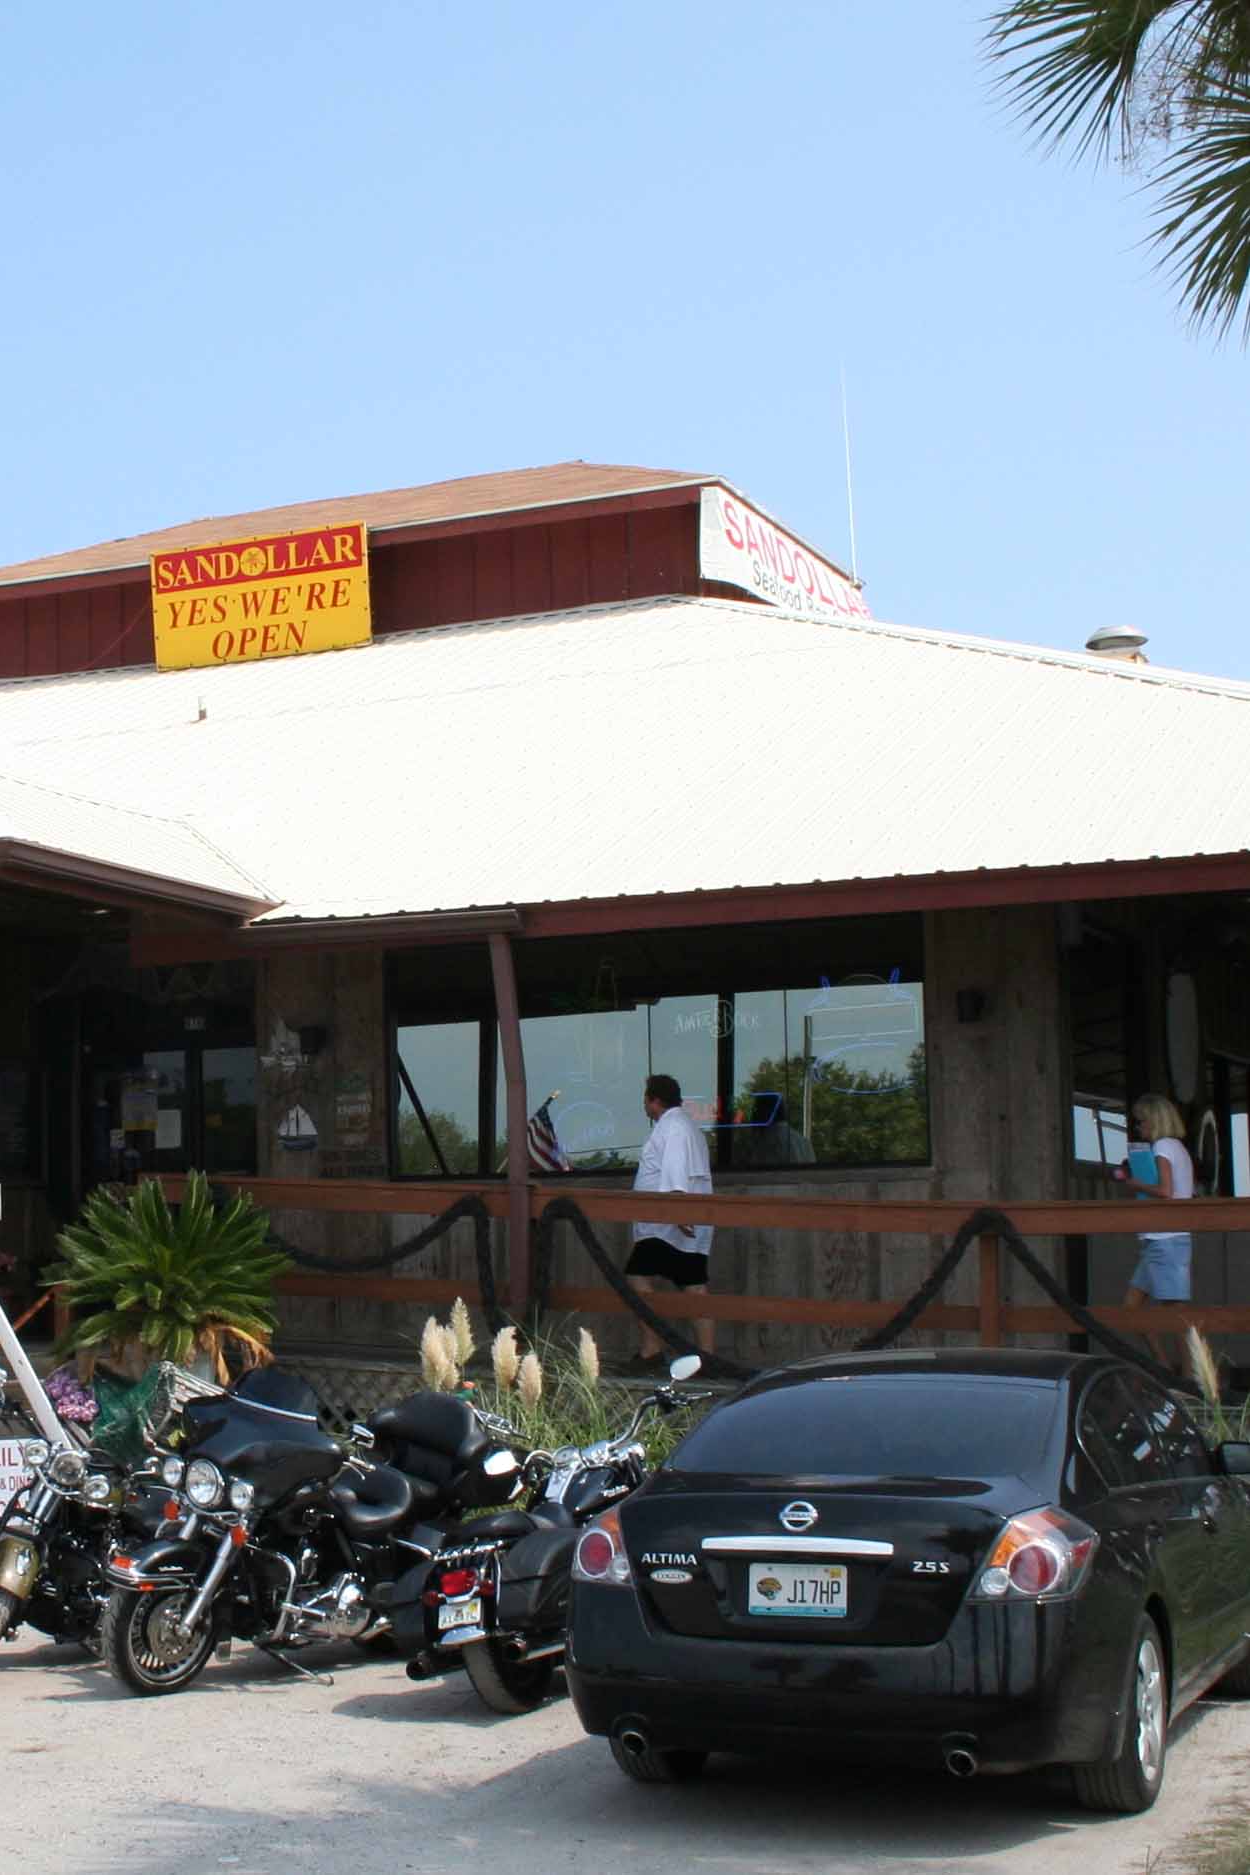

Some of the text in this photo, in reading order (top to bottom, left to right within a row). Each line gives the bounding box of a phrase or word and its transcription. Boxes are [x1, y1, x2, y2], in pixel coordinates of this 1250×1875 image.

[157, 534, 357, 589] SANDOLLAR
[168, 577, 352, 629] YES WE'RE
[212, 620, 308, 660] OPEN
[0, 1479, 7, 1491] &
[641, 1552, 698, 1566] ALTIMA
[786, 1579, 842, 1605] J17HP
